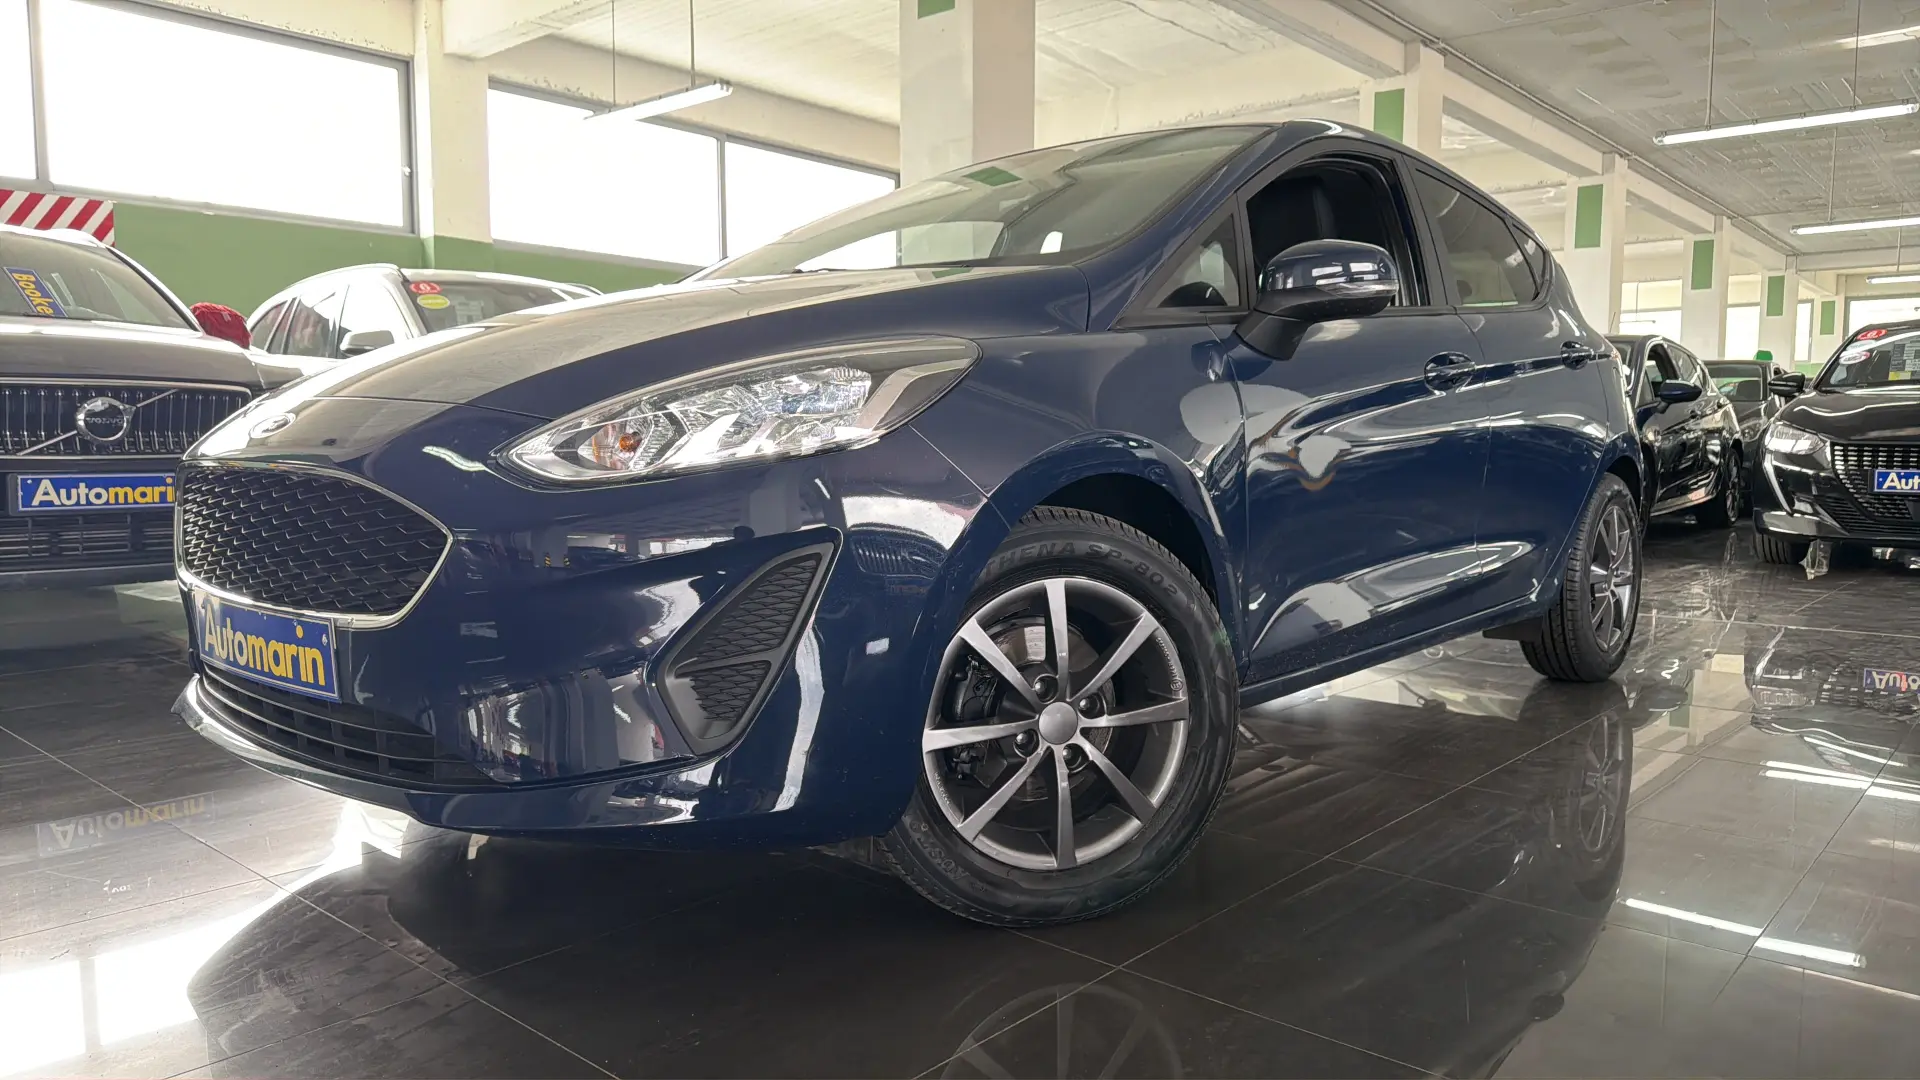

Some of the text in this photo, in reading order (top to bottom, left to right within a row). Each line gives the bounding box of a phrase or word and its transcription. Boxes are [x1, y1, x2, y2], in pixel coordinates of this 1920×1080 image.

[31, 478, 175, 506] Automari
[1086, 544, 1178, 596] SP-802
[204, 603, 326, 686] Automarin
